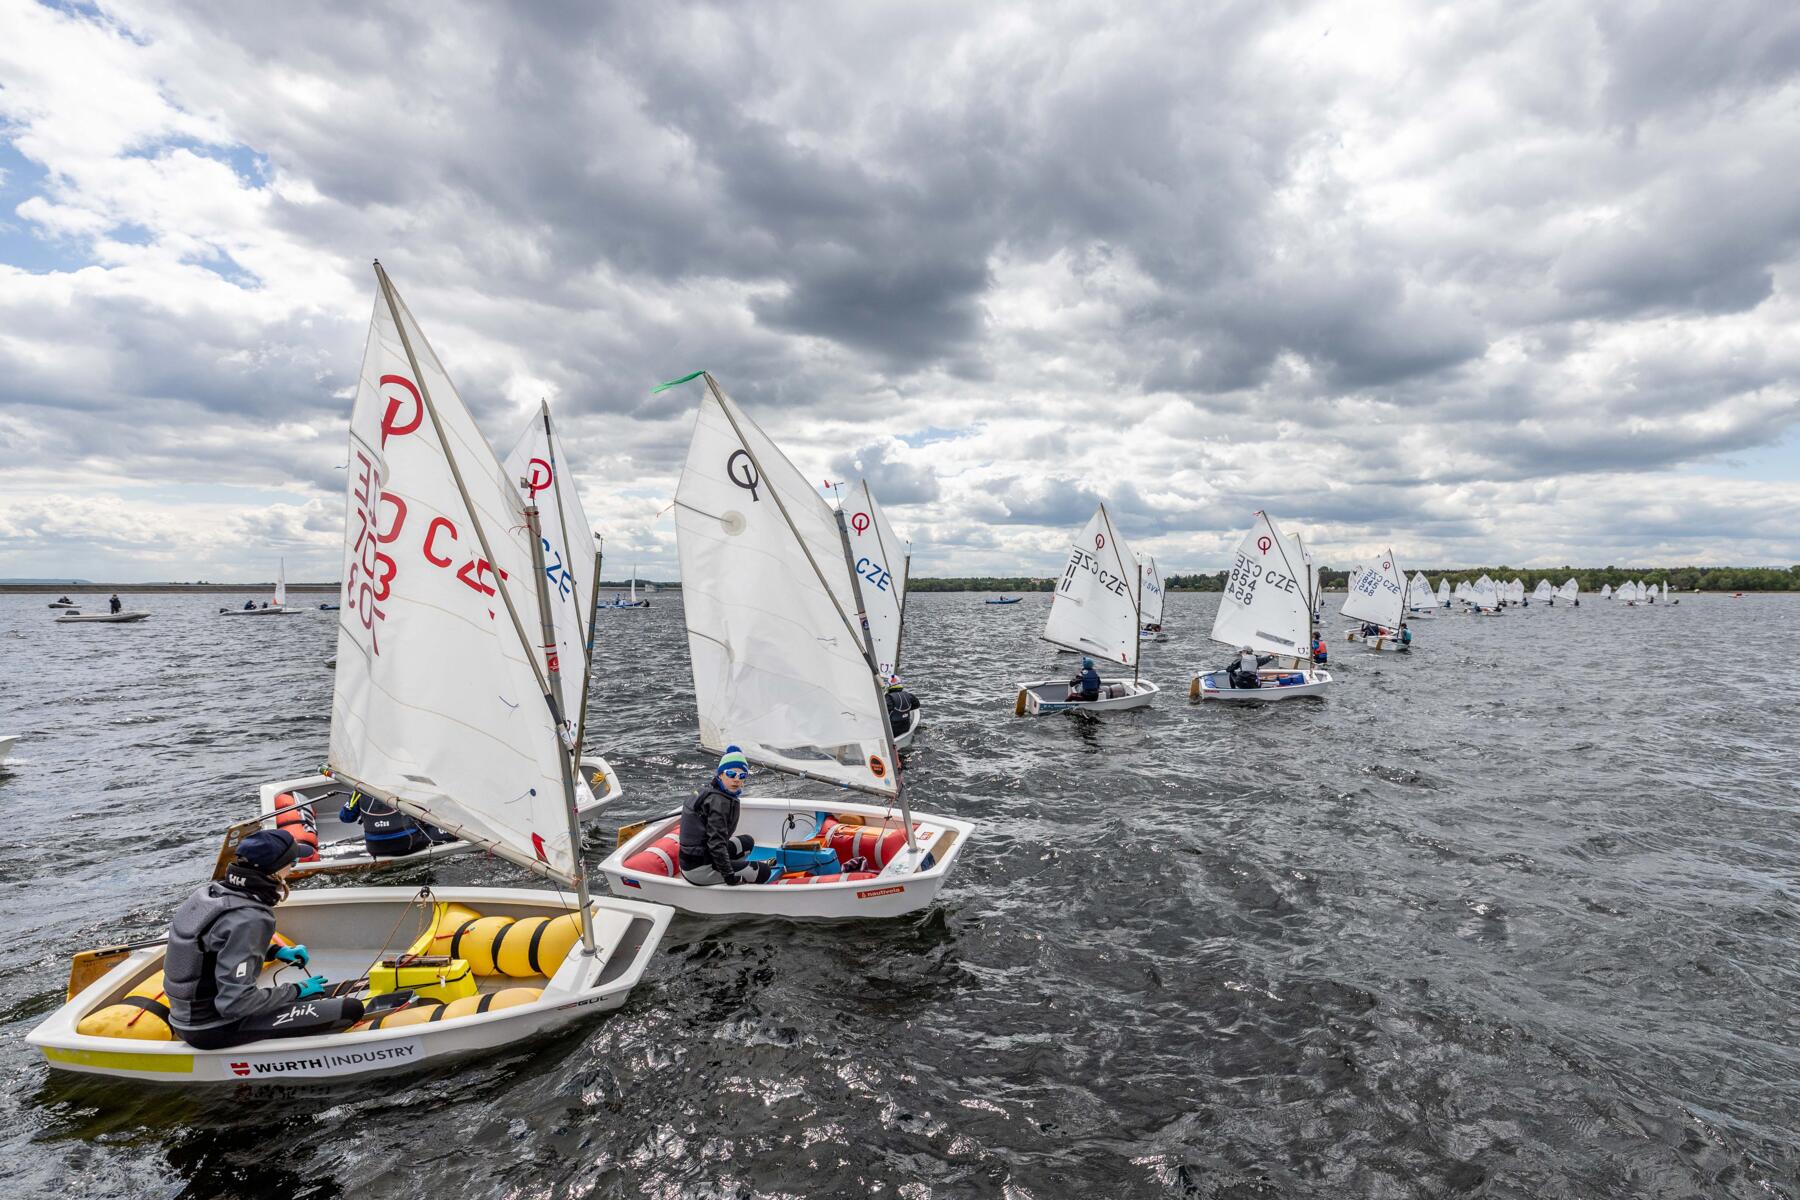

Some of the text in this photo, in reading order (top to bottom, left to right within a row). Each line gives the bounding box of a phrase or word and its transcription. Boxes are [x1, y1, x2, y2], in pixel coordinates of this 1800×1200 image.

[855, 556, 892, 592] CZE
[1099, 570, 1127, 597] CZE
[1231, 568, 1257, 592] 854
[1265, 570, 1297, 594] CZE
[1383, 579, 1400, 595] CZE
[272, 1003, 319, 1027] Zhik
[253, 1045, 415, 1073] WÜRTH INDUSTRY
